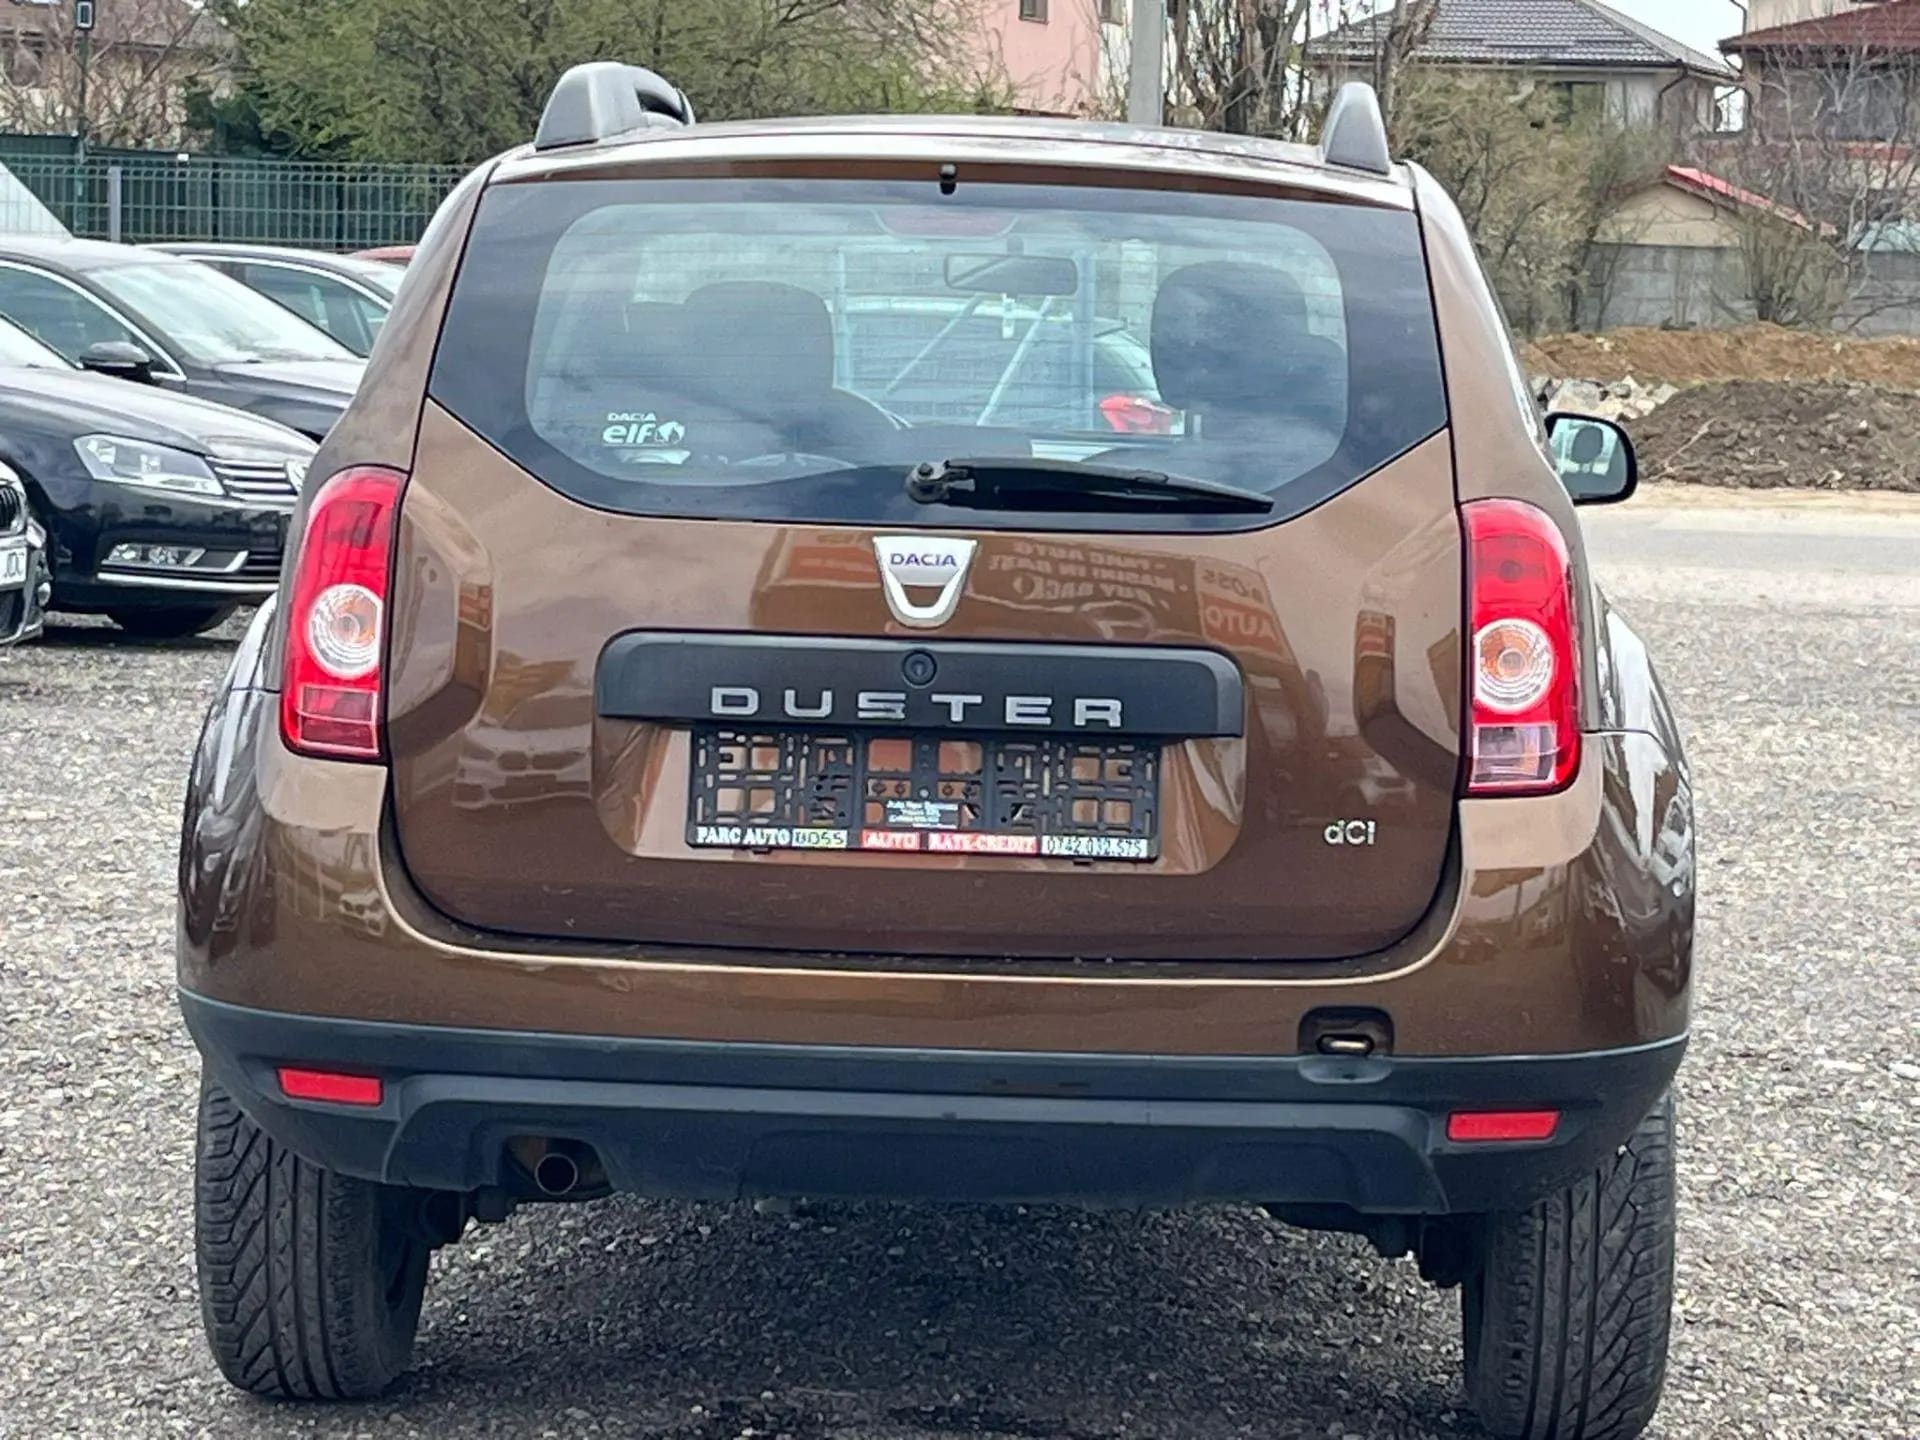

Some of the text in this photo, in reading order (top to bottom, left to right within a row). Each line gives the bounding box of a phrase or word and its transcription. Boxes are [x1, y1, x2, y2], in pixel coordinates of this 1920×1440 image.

[607, 412, 657, 422] DACIA
[602, 423, 657, 445] elf
[890, 552, 957, 567] DACIA
[711, 686, 1124, 728] DUSTER
[697, 826, 741, 843] PARC
[743, 827, 790, 845] AUTO
